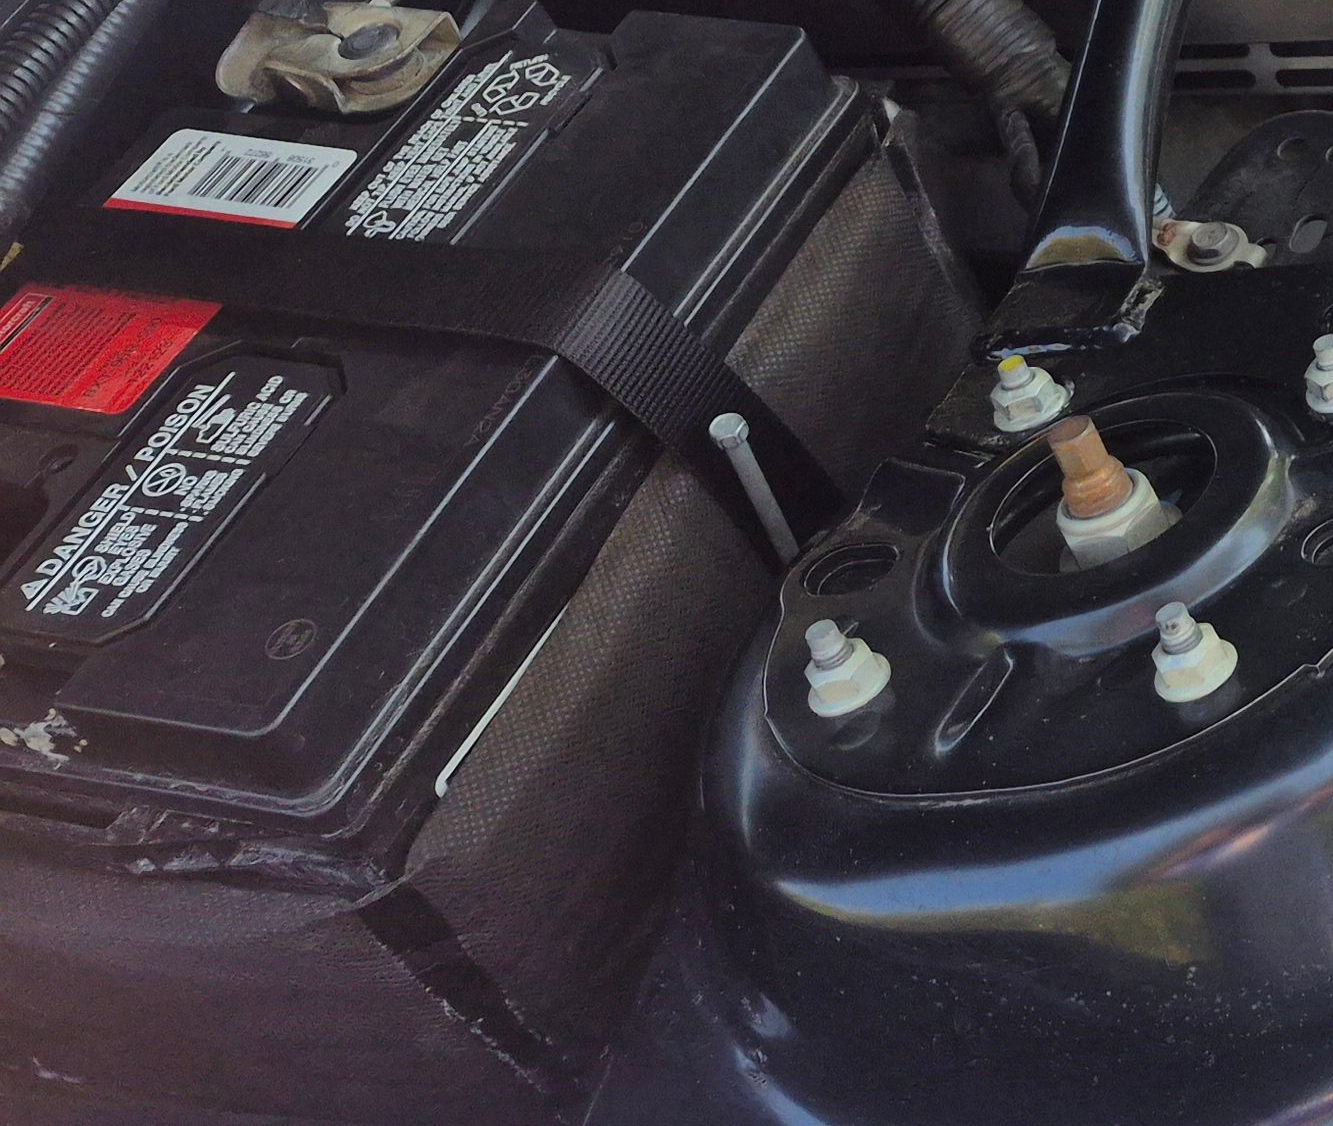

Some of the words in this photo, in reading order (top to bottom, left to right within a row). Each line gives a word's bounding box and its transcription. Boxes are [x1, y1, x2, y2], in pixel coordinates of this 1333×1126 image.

[208, 400, 265, 453] SULFURIC
[251, 373, 287, 402] ACID
[39, 479, 131, 578] DANGER
[133, 381, 217, 463] POISON
[172, 473, 201, 497] NO
[91, 509, 139, 555] SHIELD
[94, 520, 160, 586] EXPLOSIVE
[106, 522, 143, 556] EYES
[109, 545, 155, 588] GASES
